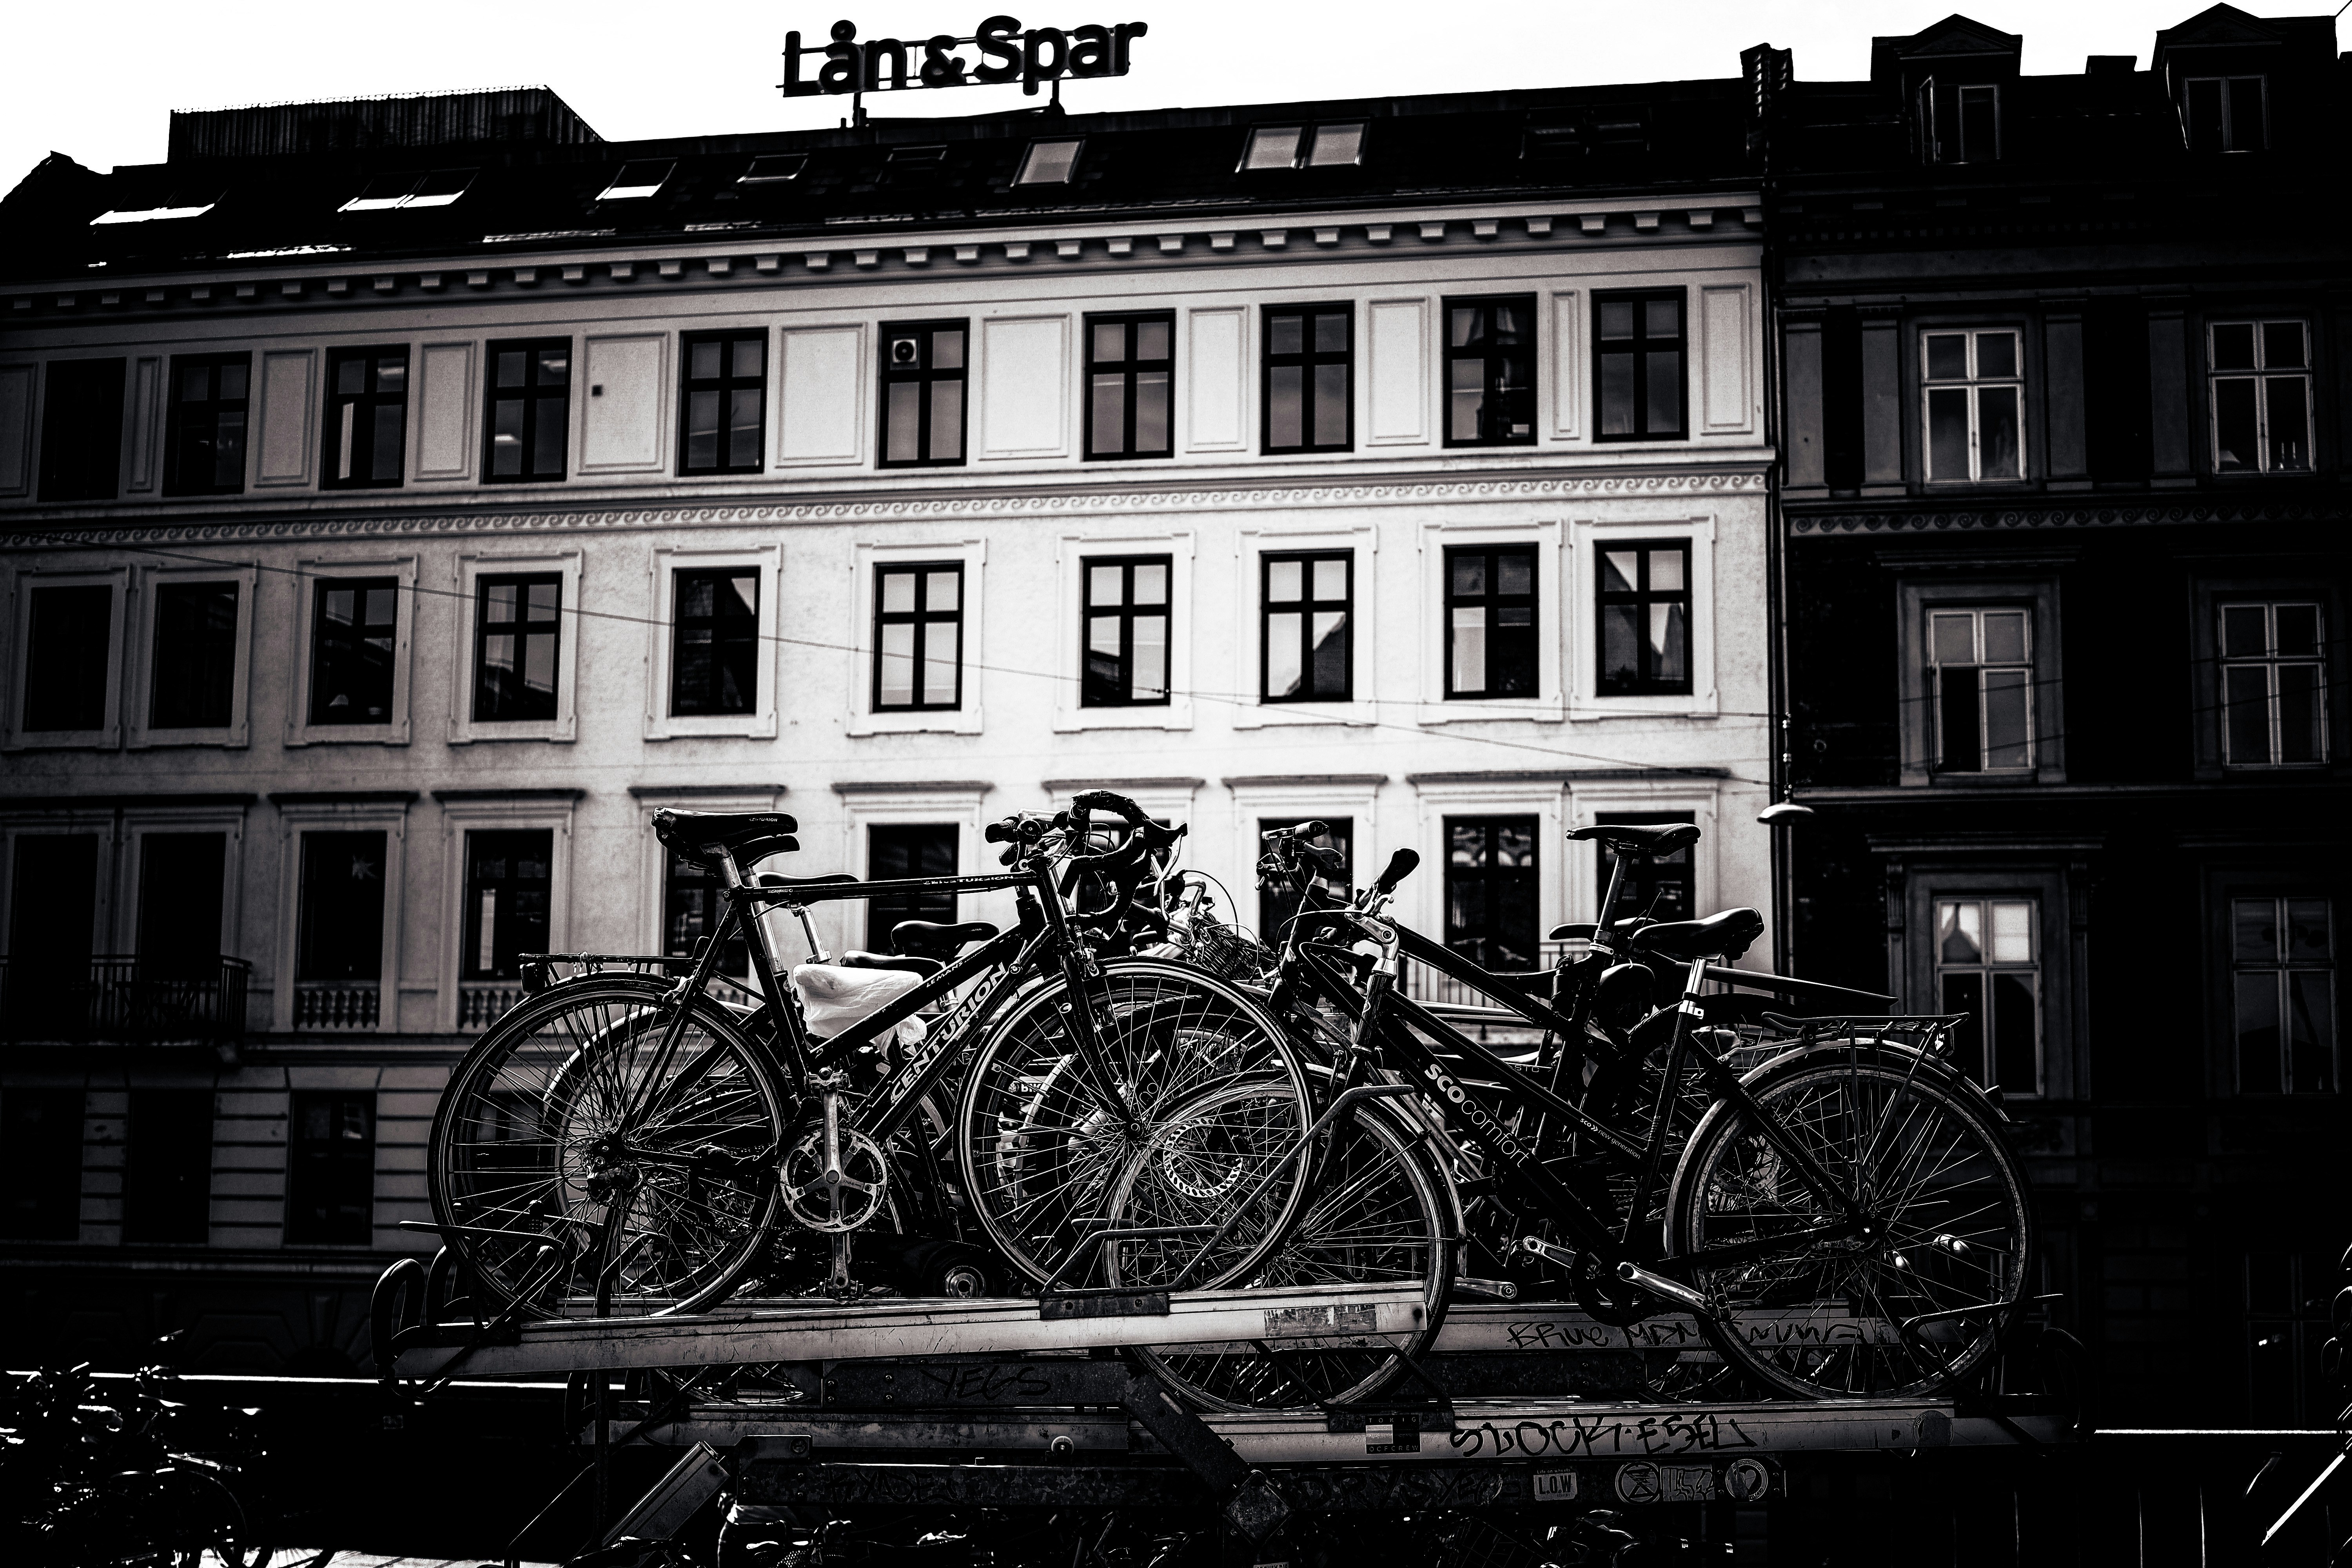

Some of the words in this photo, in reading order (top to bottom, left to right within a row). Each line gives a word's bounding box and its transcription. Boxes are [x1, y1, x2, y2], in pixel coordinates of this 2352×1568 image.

[784, 20, 907, 94] Lån
[973, 15, 1147, 95] Spar
[891, 962, 1006, 1100] CENTURION
[1598, 1130, 1611, 1140] new
[1611, 1138, 1641, 1159] generation
